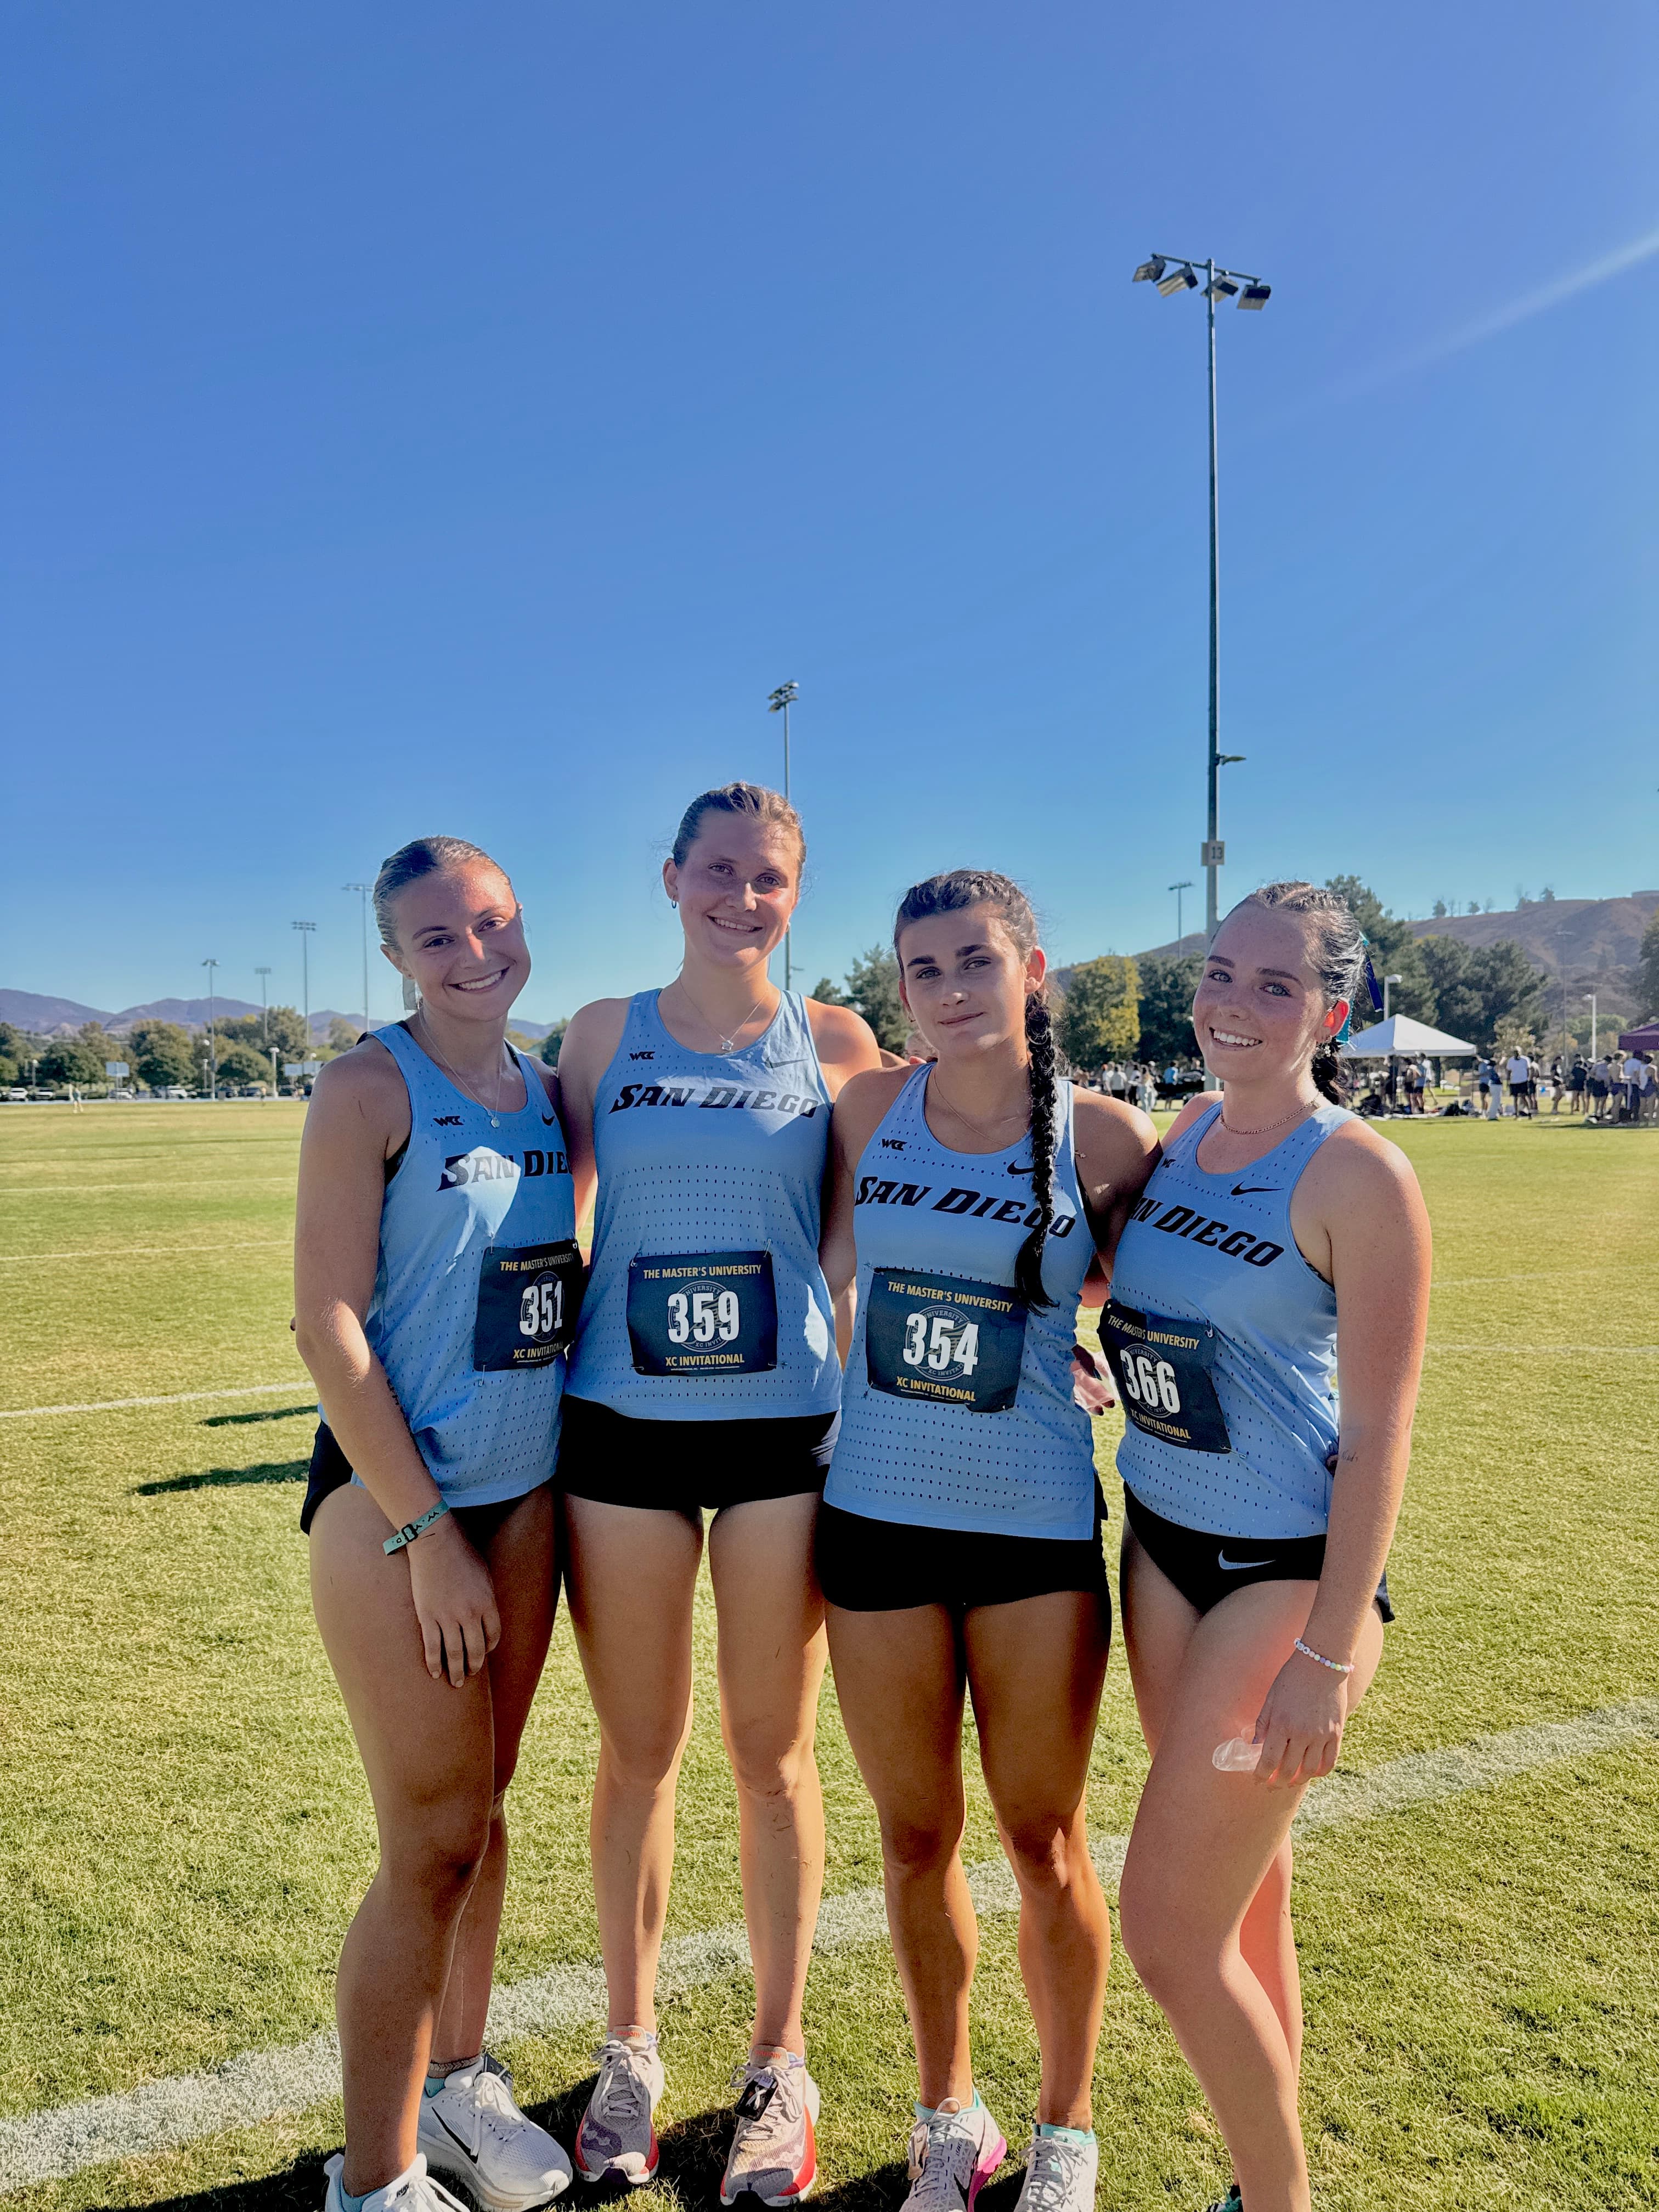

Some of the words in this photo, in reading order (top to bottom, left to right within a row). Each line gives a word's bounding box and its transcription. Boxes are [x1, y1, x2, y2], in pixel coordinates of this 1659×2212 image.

[1211, 846, 1223, 860] 13
[608, 1084, 695, 1115] SAN
[698, 1087, 819, 1118] DIEGO
[436, 1153, 514, 1192] SAN
[523, 1150, 572, 1177] DIE
[855, 1176, 933, 1206] SAN
[1152, 1205, 1284, 1267] DIEGO
[500, 1261, 518, 1271] THE
[521, 1257, 548, 1271] MASTER'S
[644, 1269, 659, 1279] THE
[662, 1267, 707, 1278] MASTER'S
[709, 1265, 761, 1277] UNIVERSITY
[685, 1285, 721, 1296] NIVERSITY
[888, 1282, 905, 1293] THE
[907, 1285, 952, 1302] MASTER'S
[955, 1293, 1013, 1312] UNIVERSITY
[520, 1280, 562, 1335] 351
[668, 1291, 739, 1342] 359
[903, 1313, 979, 1376] 354
[1108, 1315, 1124, 1329] THE
[1147, 1331, 1200, 1350] UNIVERSITY
[513, 1349, 525, 1359] XC
[665, 1356, 678, 1366] XC
[680, 1353, 744, 1366] INVITATIONAL
[1129, 1348, 1158, 1362] NIVERSITY
[896, 1376, 909, 1387] XC
[911, 1379, 976, 1401] INVITATIONAL
[1120, 1350, 1180, 1413] 366
[1130, 1408, 1138, 1418] XC
[1138, 1412, 1191, 1439] INVITATIONAL
